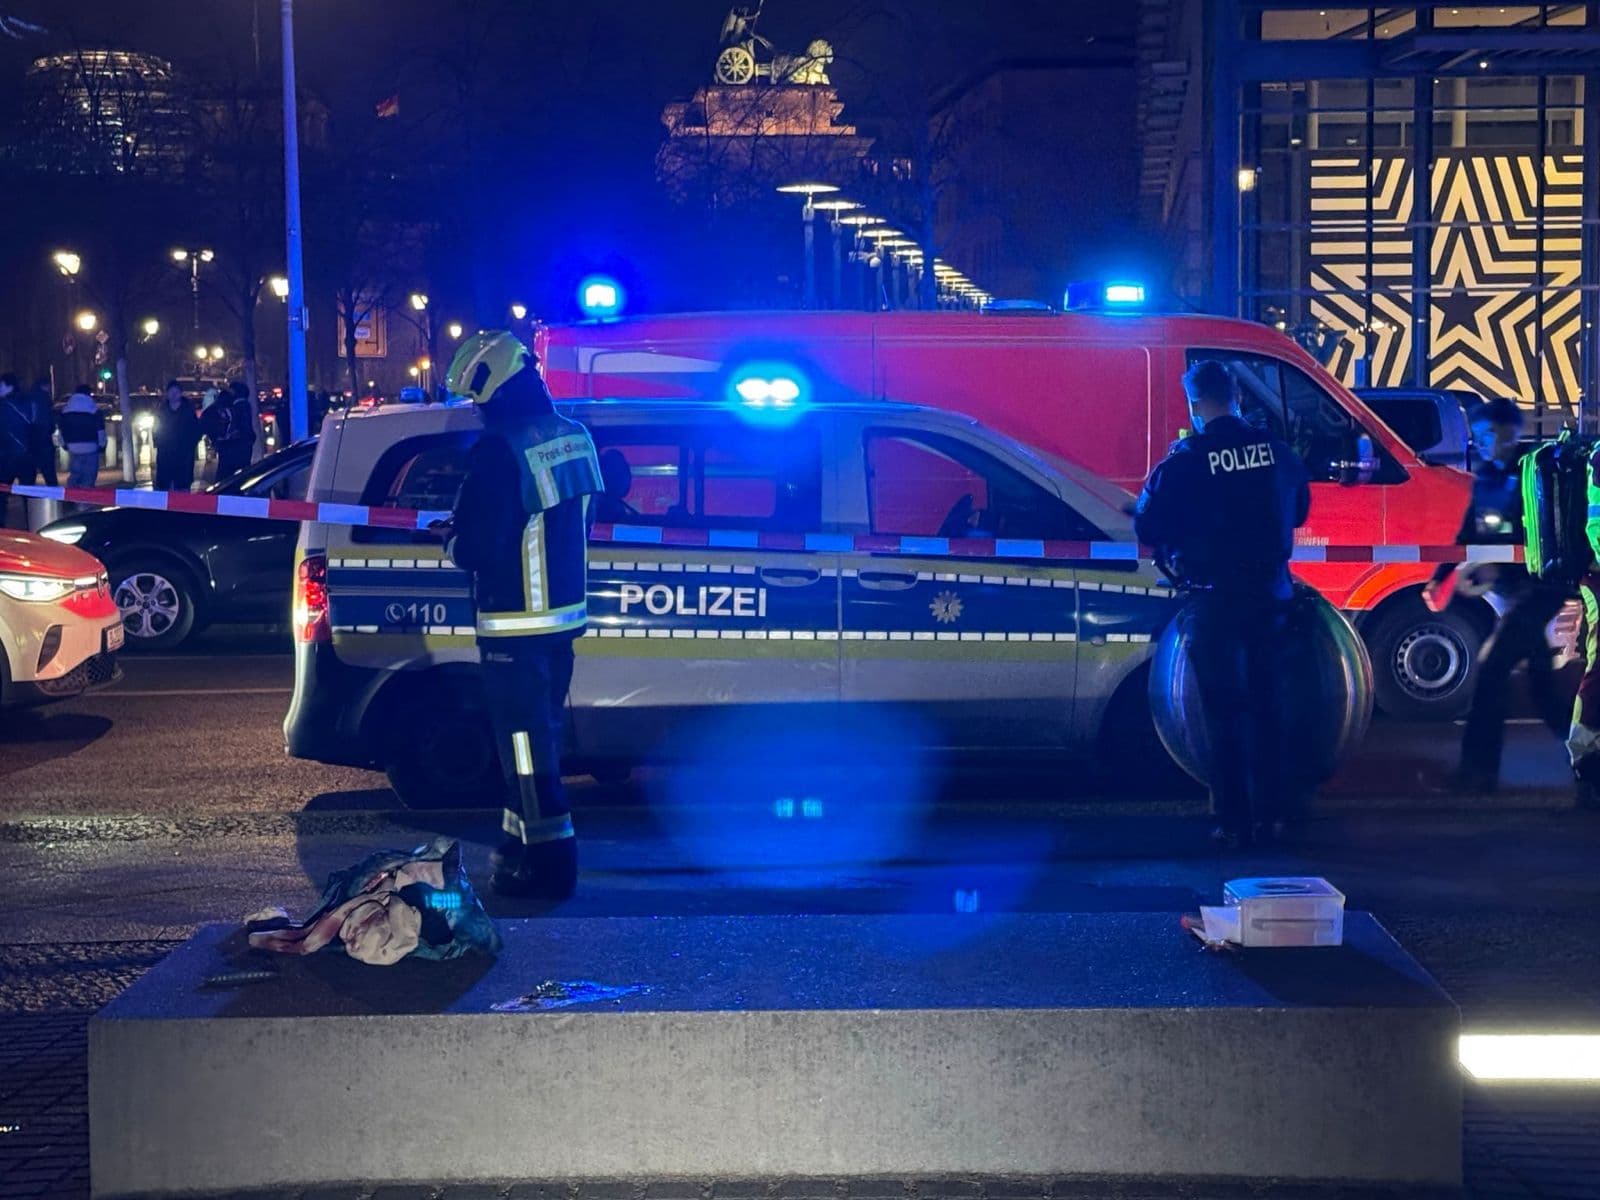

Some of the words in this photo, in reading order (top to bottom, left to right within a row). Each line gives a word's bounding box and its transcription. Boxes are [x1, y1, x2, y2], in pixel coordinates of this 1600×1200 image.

[1208, 443, 1275, 475] POLIZEI
[407, 603, 446, 623] 110
[620, 584, 766, 617] POLIZEI
